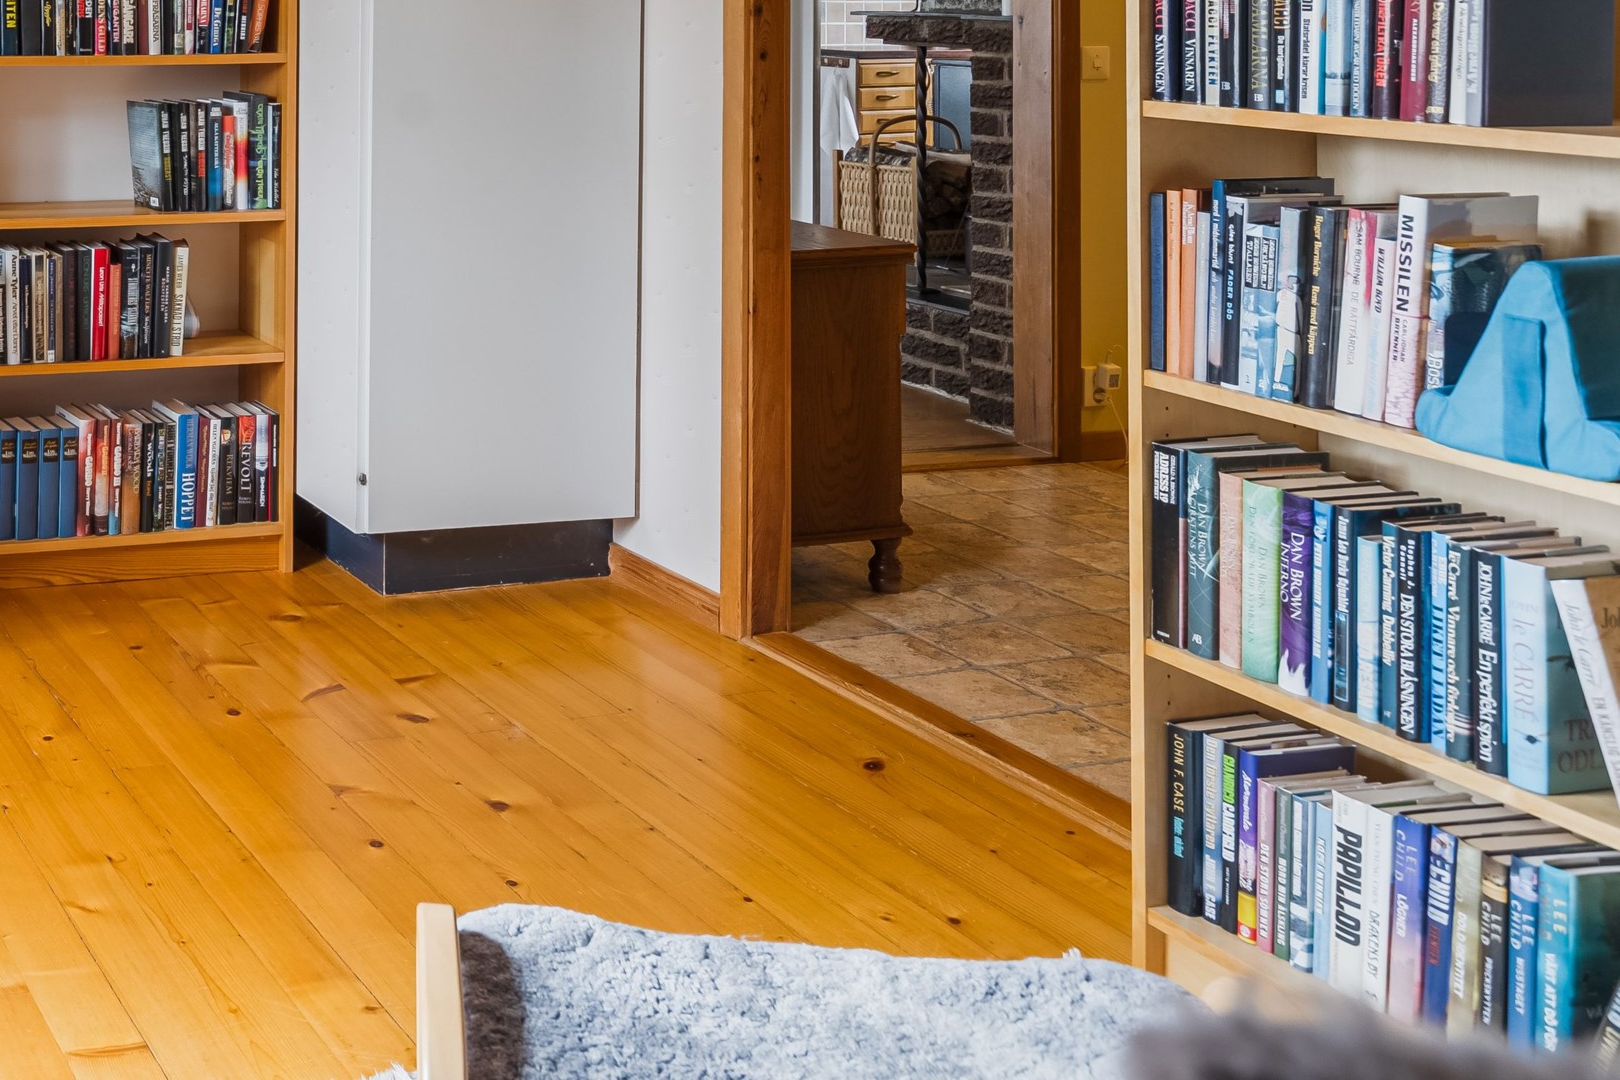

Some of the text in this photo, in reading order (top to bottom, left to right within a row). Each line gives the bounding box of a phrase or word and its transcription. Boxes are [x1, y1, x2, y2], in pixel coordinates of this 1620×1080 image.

[96, 24, 107, 53] GULD
[1207, 34, 1220, 86] FLYKTEN
[1154, 33, 1168, 93] SANNINGEN
[1184, 37, 1198, 93] VINNAREN
[1312, 214, 1325, 240] Roger
[9, 254, 21, 299] Anne Tyler
[1311, 240, 1324, 278] Borniche
[1352, 248, 1364, 286] BOURNE
[1395, 214, 1415, 312] MISSILEN
[1226, 268, 1236, 299] FADER
[1311, 285, 1323, 307] René
[1309, 307, 1321, 325] med
[240, 441, 253, 494] REVOLT
[1159, 452, 1170, 505] ADRESS 19
[180, 471, 196, 522] HOPPET
[1195, 502, 1208, 570] DAN BROWN
[1382, 534, 1396, 569] Victor
[1406, 538, 1416, 577] Stephen
[1279, 541, 1291, 604] INFERNO
[1289, 531, 1306, 622] DAN BROWN
[1381, 567, 1396, 613] Canning
[1446, 605, 1461, 659] Vinnare
[1399, 592, 1419, 735] DEN STORA BLÅSNINGEN
[1476, 561, 1498, 763] JOHN En perfekt spion
[1173, 733, 1185, 813] JOHN F. CASE
[1205, 738, 1218, 762] Den
[1205, 762, 1218, 801] förste
[1221, 753, 1236, 864] GIANRICO CAROFIGLIO
[1204, 892, 1217, 921] CASE
[1333, 823, 1364, 948] PAPILLON
[1395, 893, 1410, 939] LÖGNER
[1480, 900, 1492, 948] CHILD
[1489, 914, 1502, 944] LEE
[1509, 898, 1522, 952] CHILD
[1521, 913, 1535, 948] LEE
[1551, 898, 1569, 937] LEE
